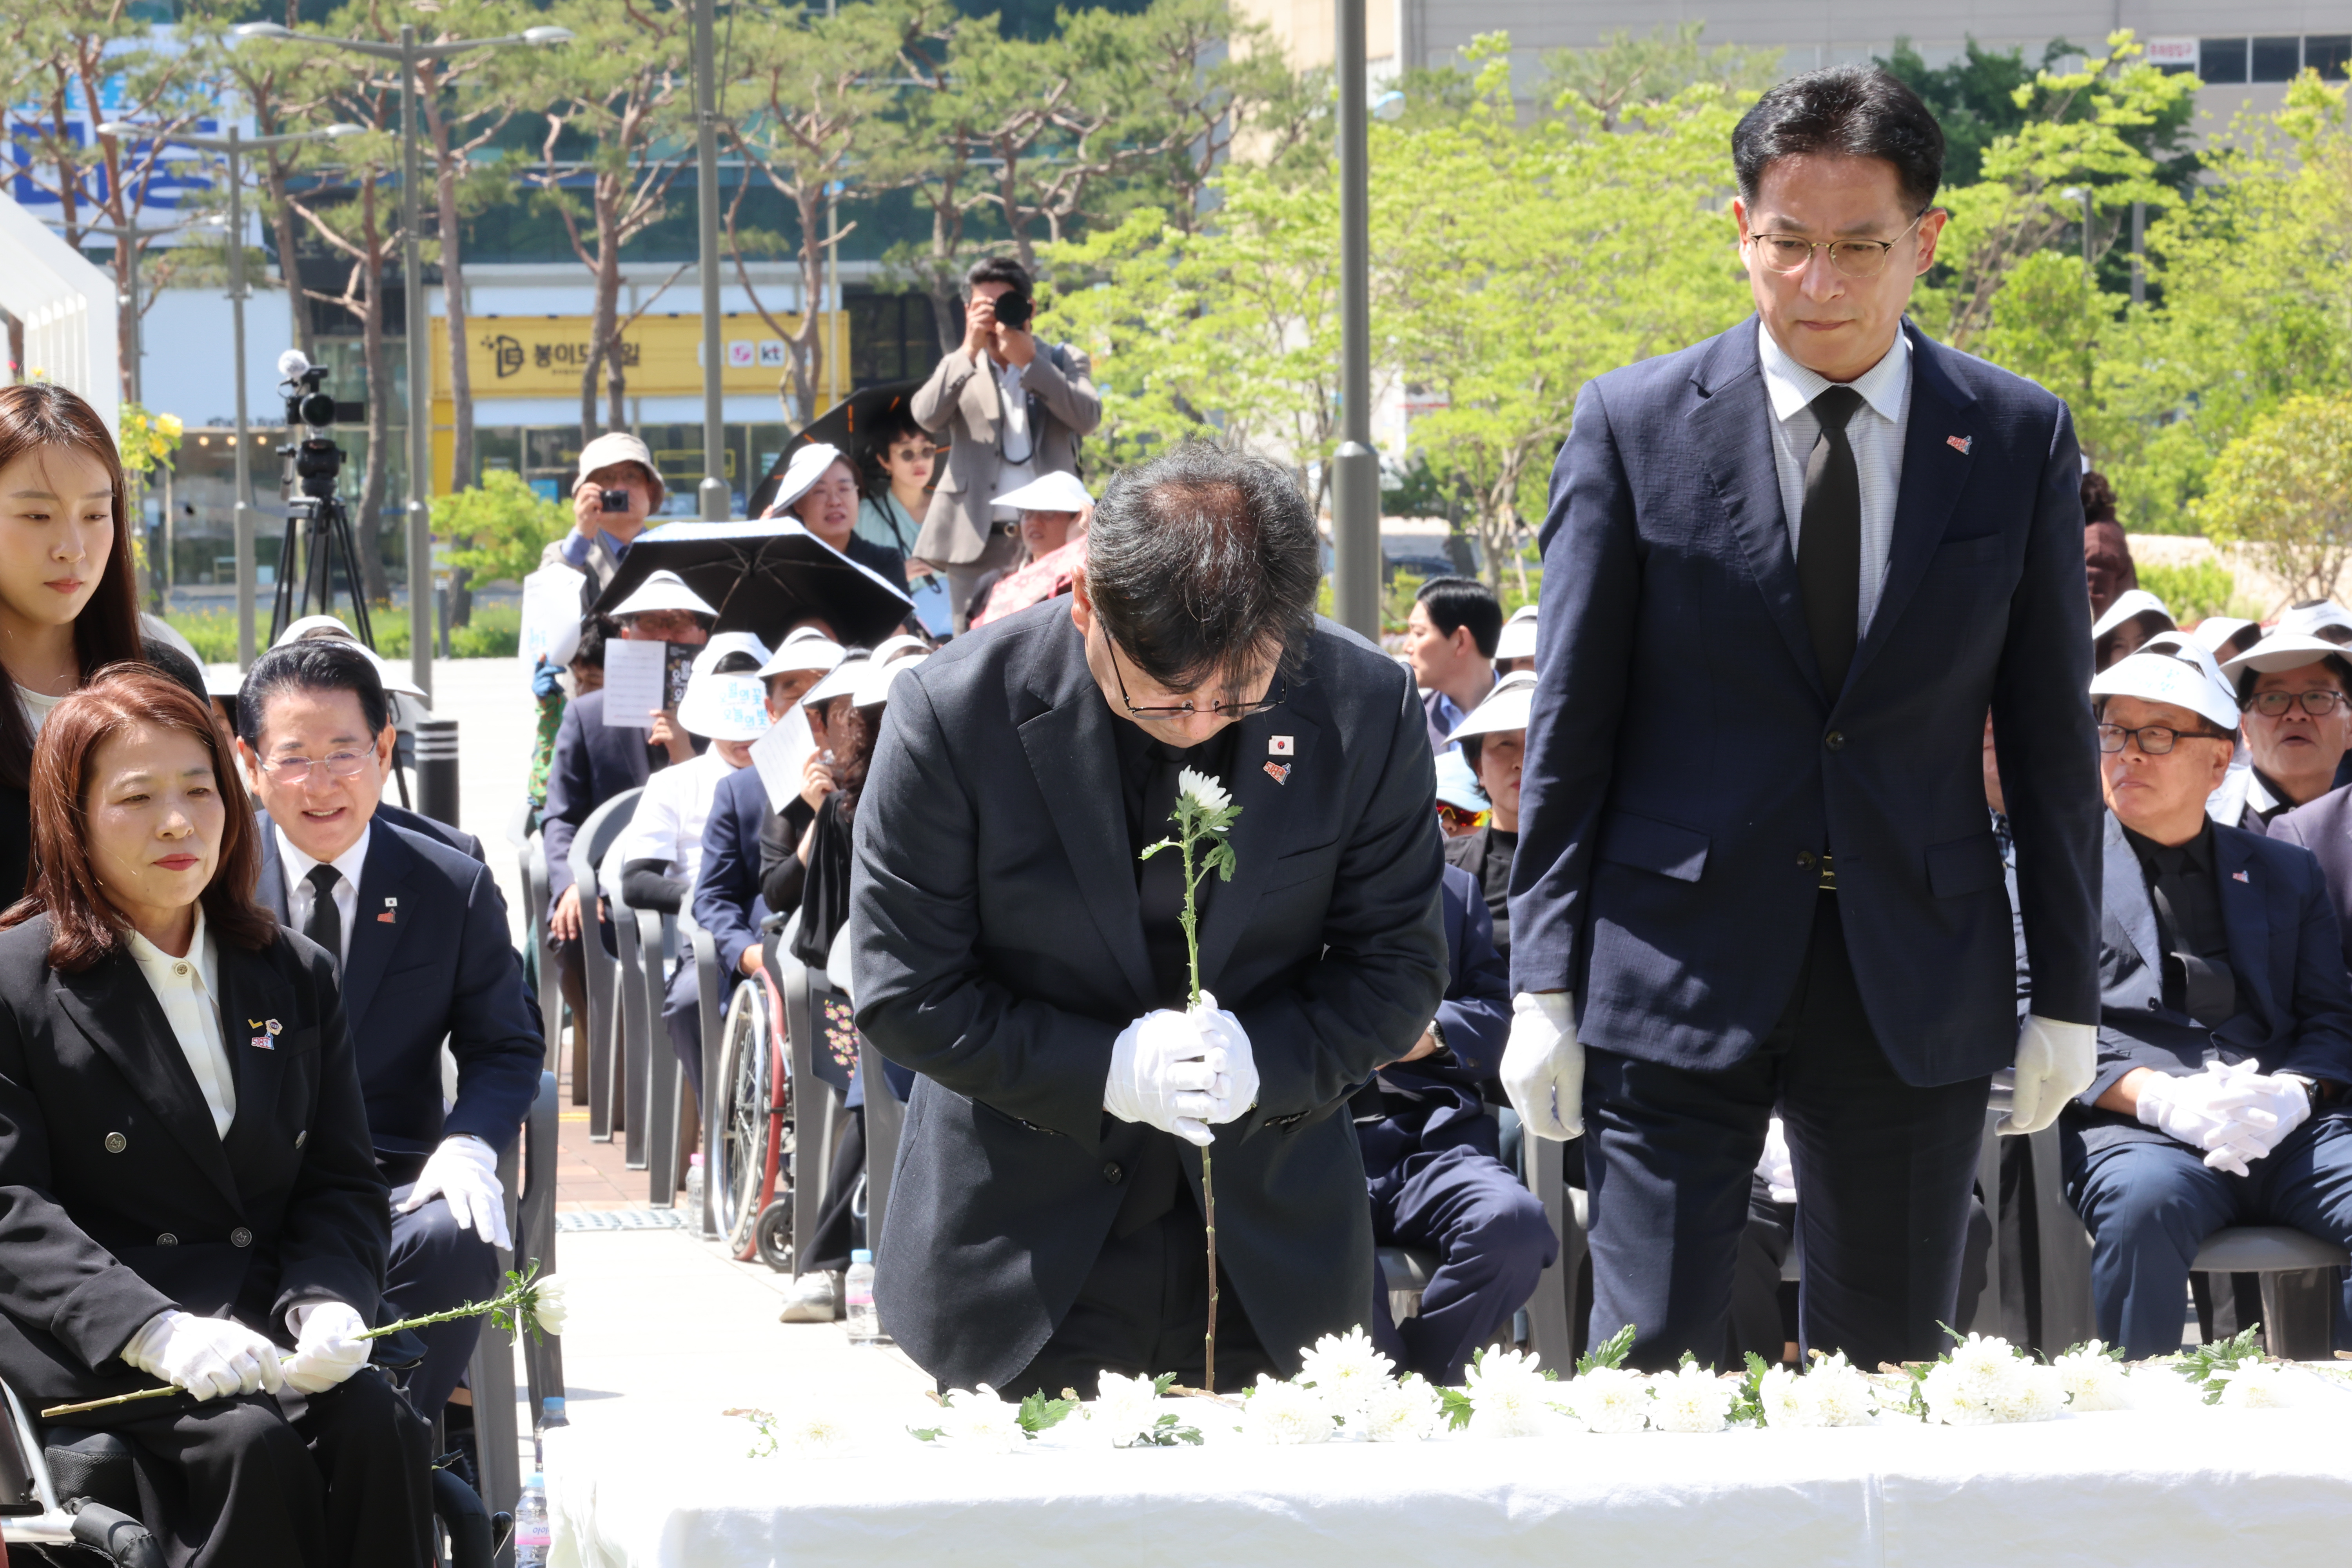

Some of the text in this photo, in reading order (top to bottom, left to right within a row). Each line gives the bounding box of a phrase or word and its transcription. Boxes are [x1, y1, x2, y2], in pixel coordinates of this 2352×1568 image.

[762, 345, 780, 360] kt
[719, 681, 762, 705] 오월의 꽃
[724, 706, 767, 727] 오늘의 빛
[533, 1527, 550, 1535] 아이
